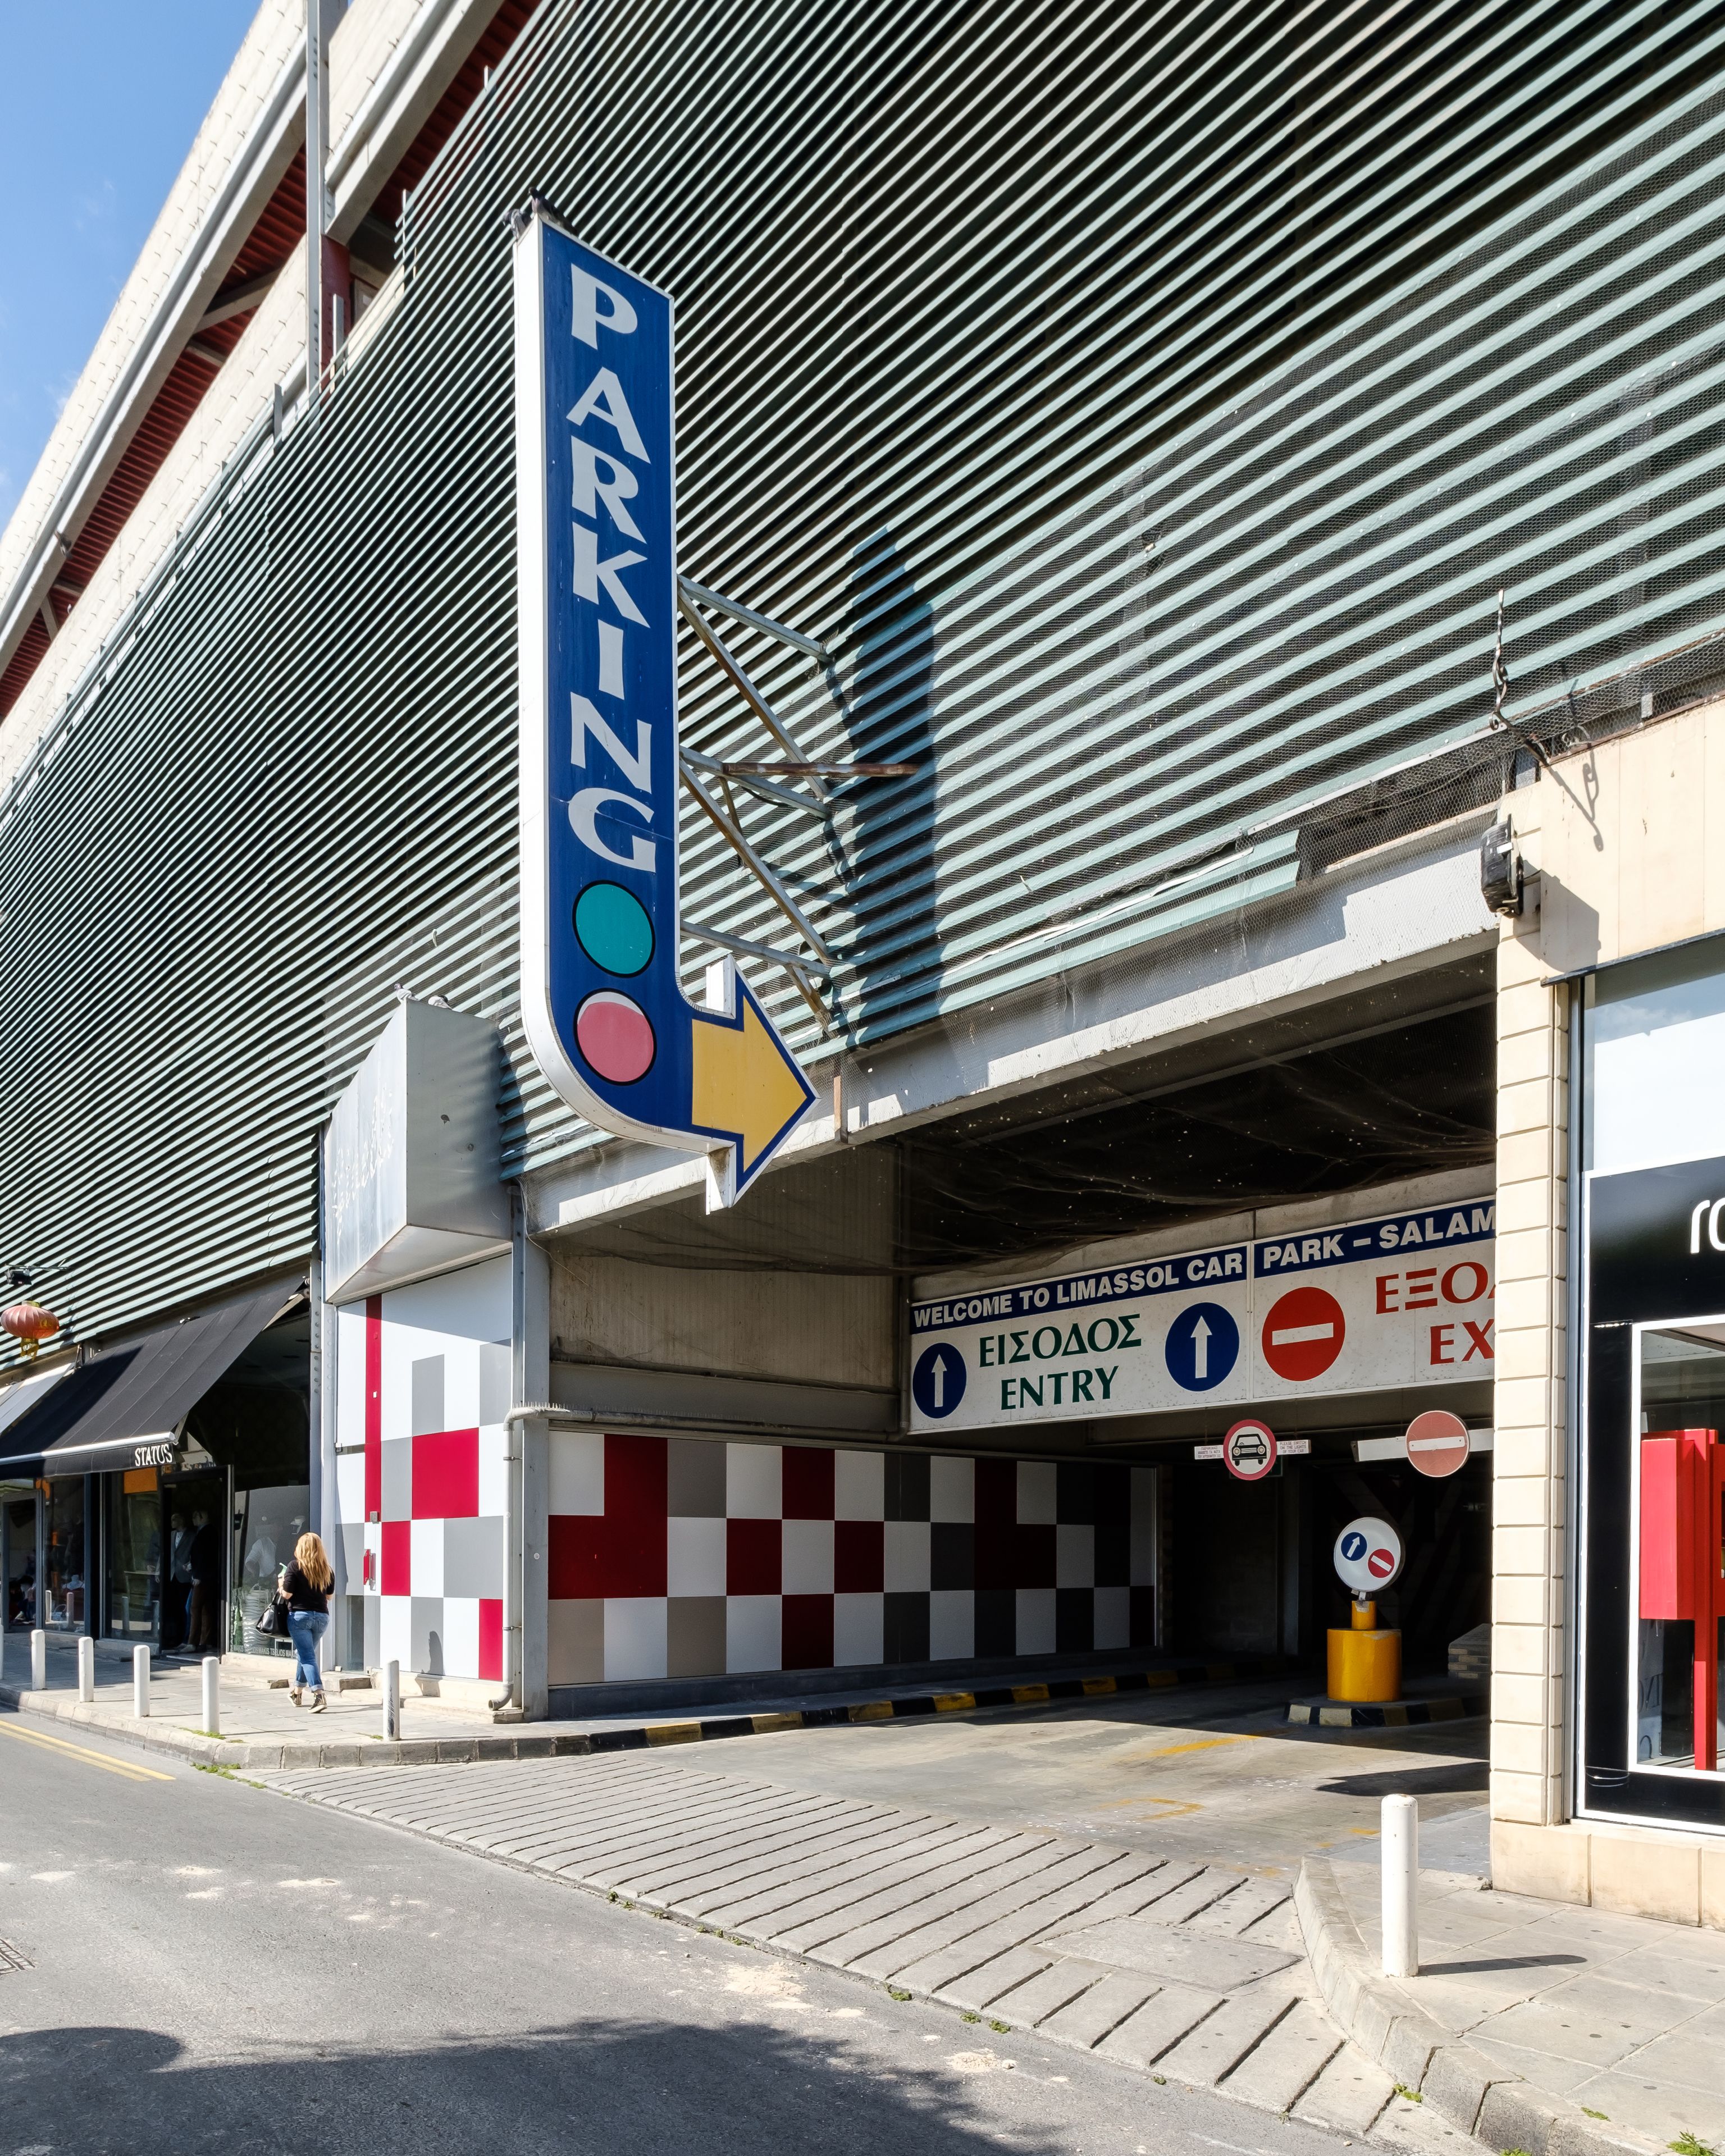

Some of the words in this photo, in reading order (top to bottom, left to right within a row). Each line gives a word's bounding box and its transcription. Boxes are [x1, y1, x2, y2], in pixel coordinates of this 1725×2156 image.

[566, 263, 656, 873] PARKING
[914, 1294, 1012, 1327] WELCOME
[1019, 1287, 1050, 1310] TO
[1057, 1264, 1179, 1304] LIMASSOL
[1187, 1253, 1243, 1281] CAR
[1263, 1234, 1344, 1269] PARK
[1379, 1205, 1496, 1249] SALAM
[1376, 1262, 1495, 1315] ΕΞΟ
[979, 1313, 1142, 1368] ΕΙΣΟΔΟΣ
[1001, 1365, 1119, 1410] ENTRY
[135, 1444, 172, 1467] STATUS
